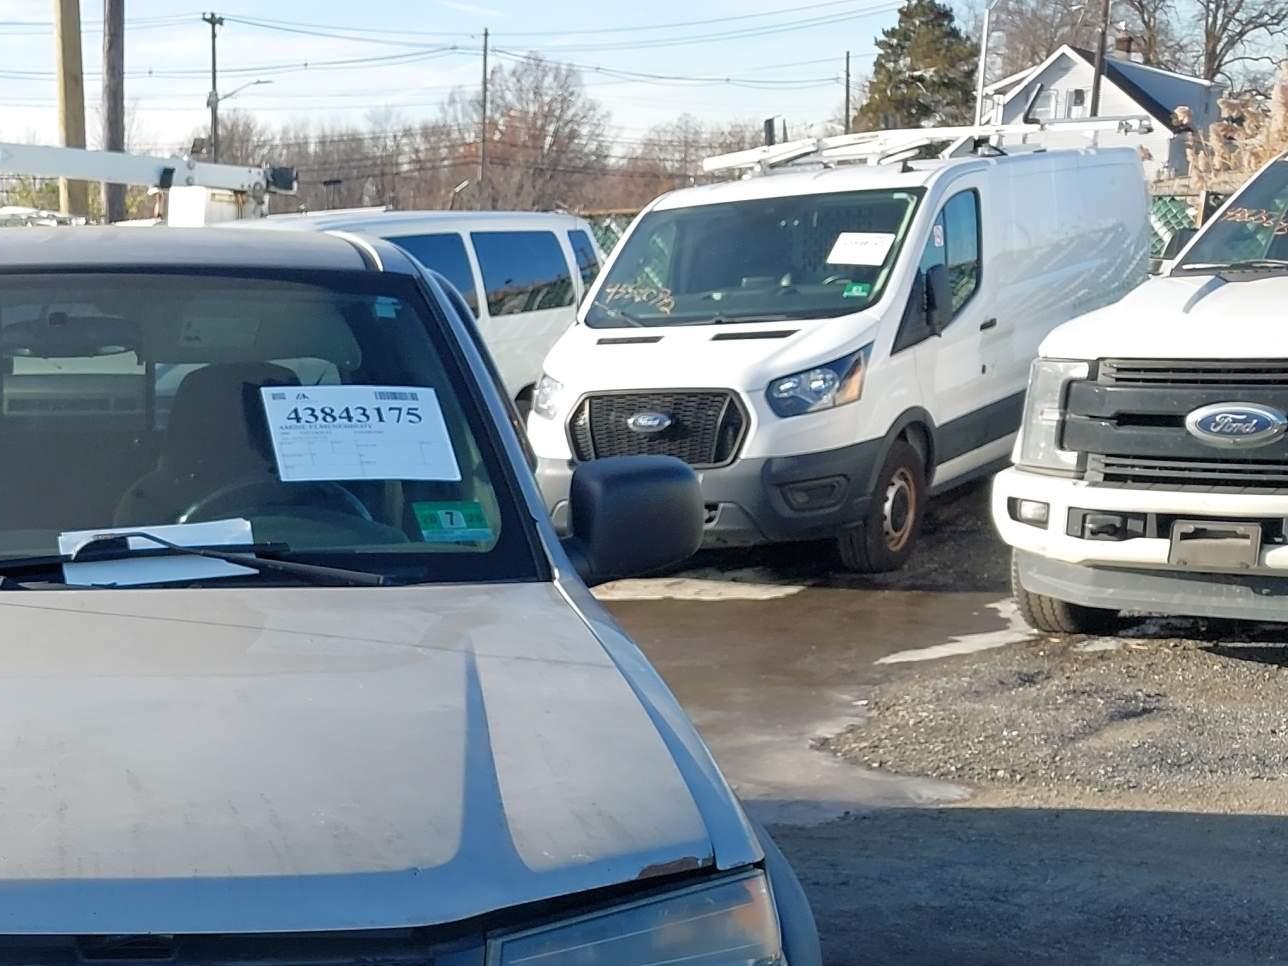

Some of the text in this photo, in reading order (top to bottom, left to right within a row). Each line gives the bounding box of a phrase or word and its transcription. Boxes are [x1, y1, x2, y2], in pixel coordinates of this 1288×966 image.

[286, 406, 423, 425] 43843175
[1209, 413, 1259, 433] Ford
[444, 511, 455, 526] 7
